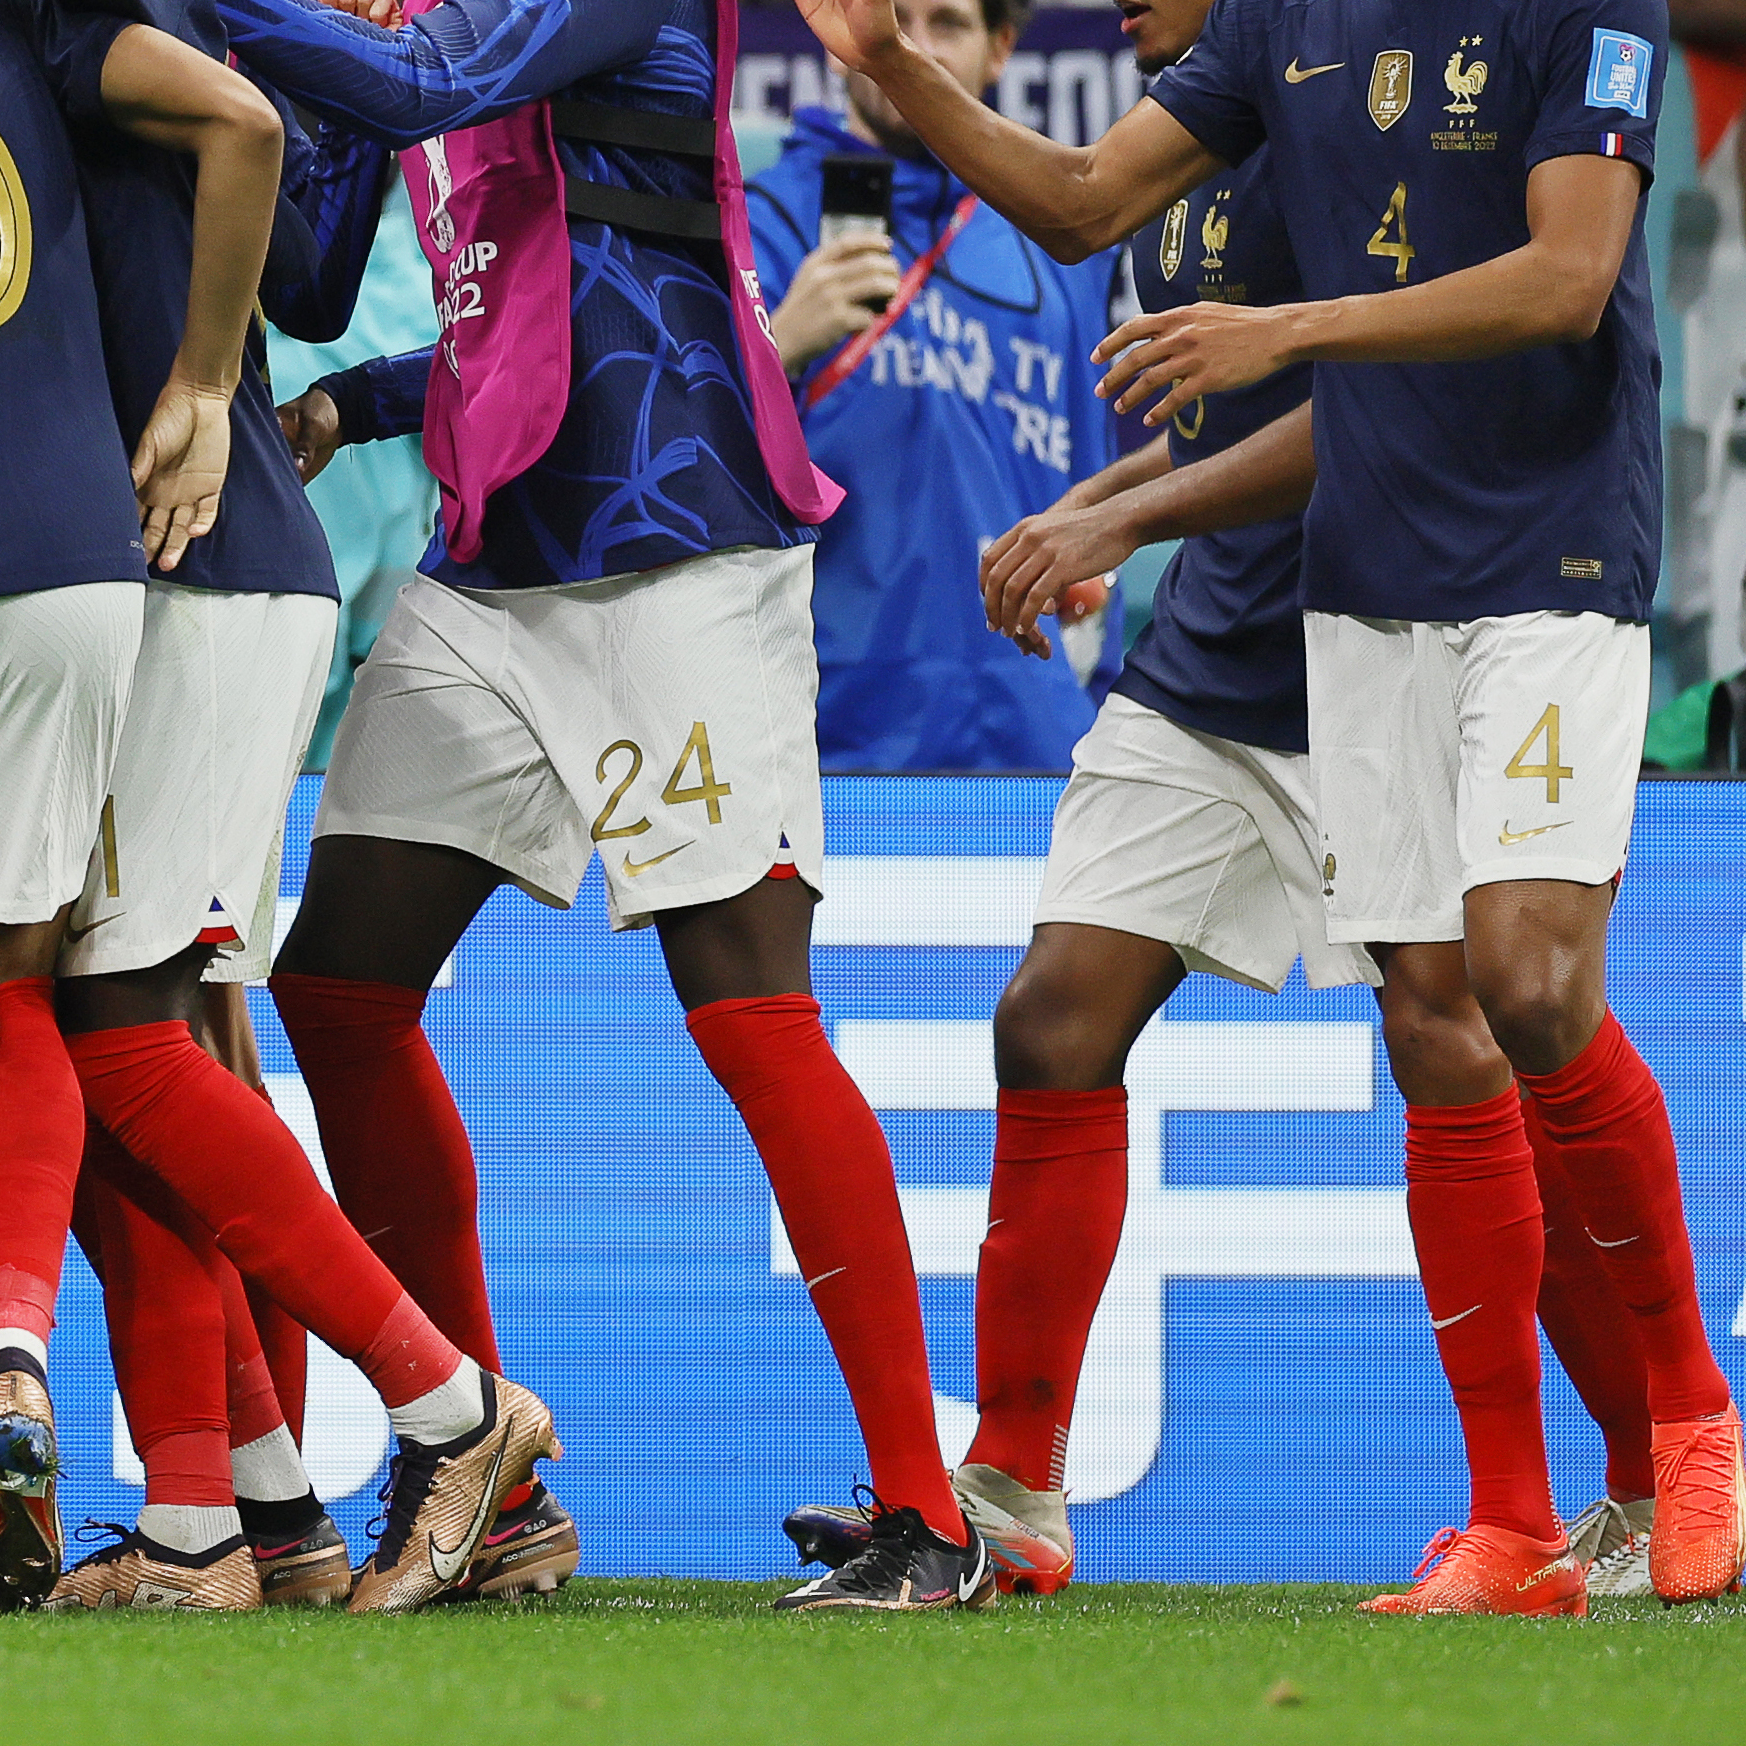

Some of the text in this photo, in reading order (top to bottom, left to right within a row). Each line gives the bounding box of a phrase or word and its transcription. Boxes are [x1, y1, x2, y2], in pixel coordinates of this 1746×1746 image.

[1380, 100, 1397, 110] FIFA
[1366, 180, 1416, 283] 4
[592, 721, 732, 844] 24
[1504, 704, 1574, 804] 4
